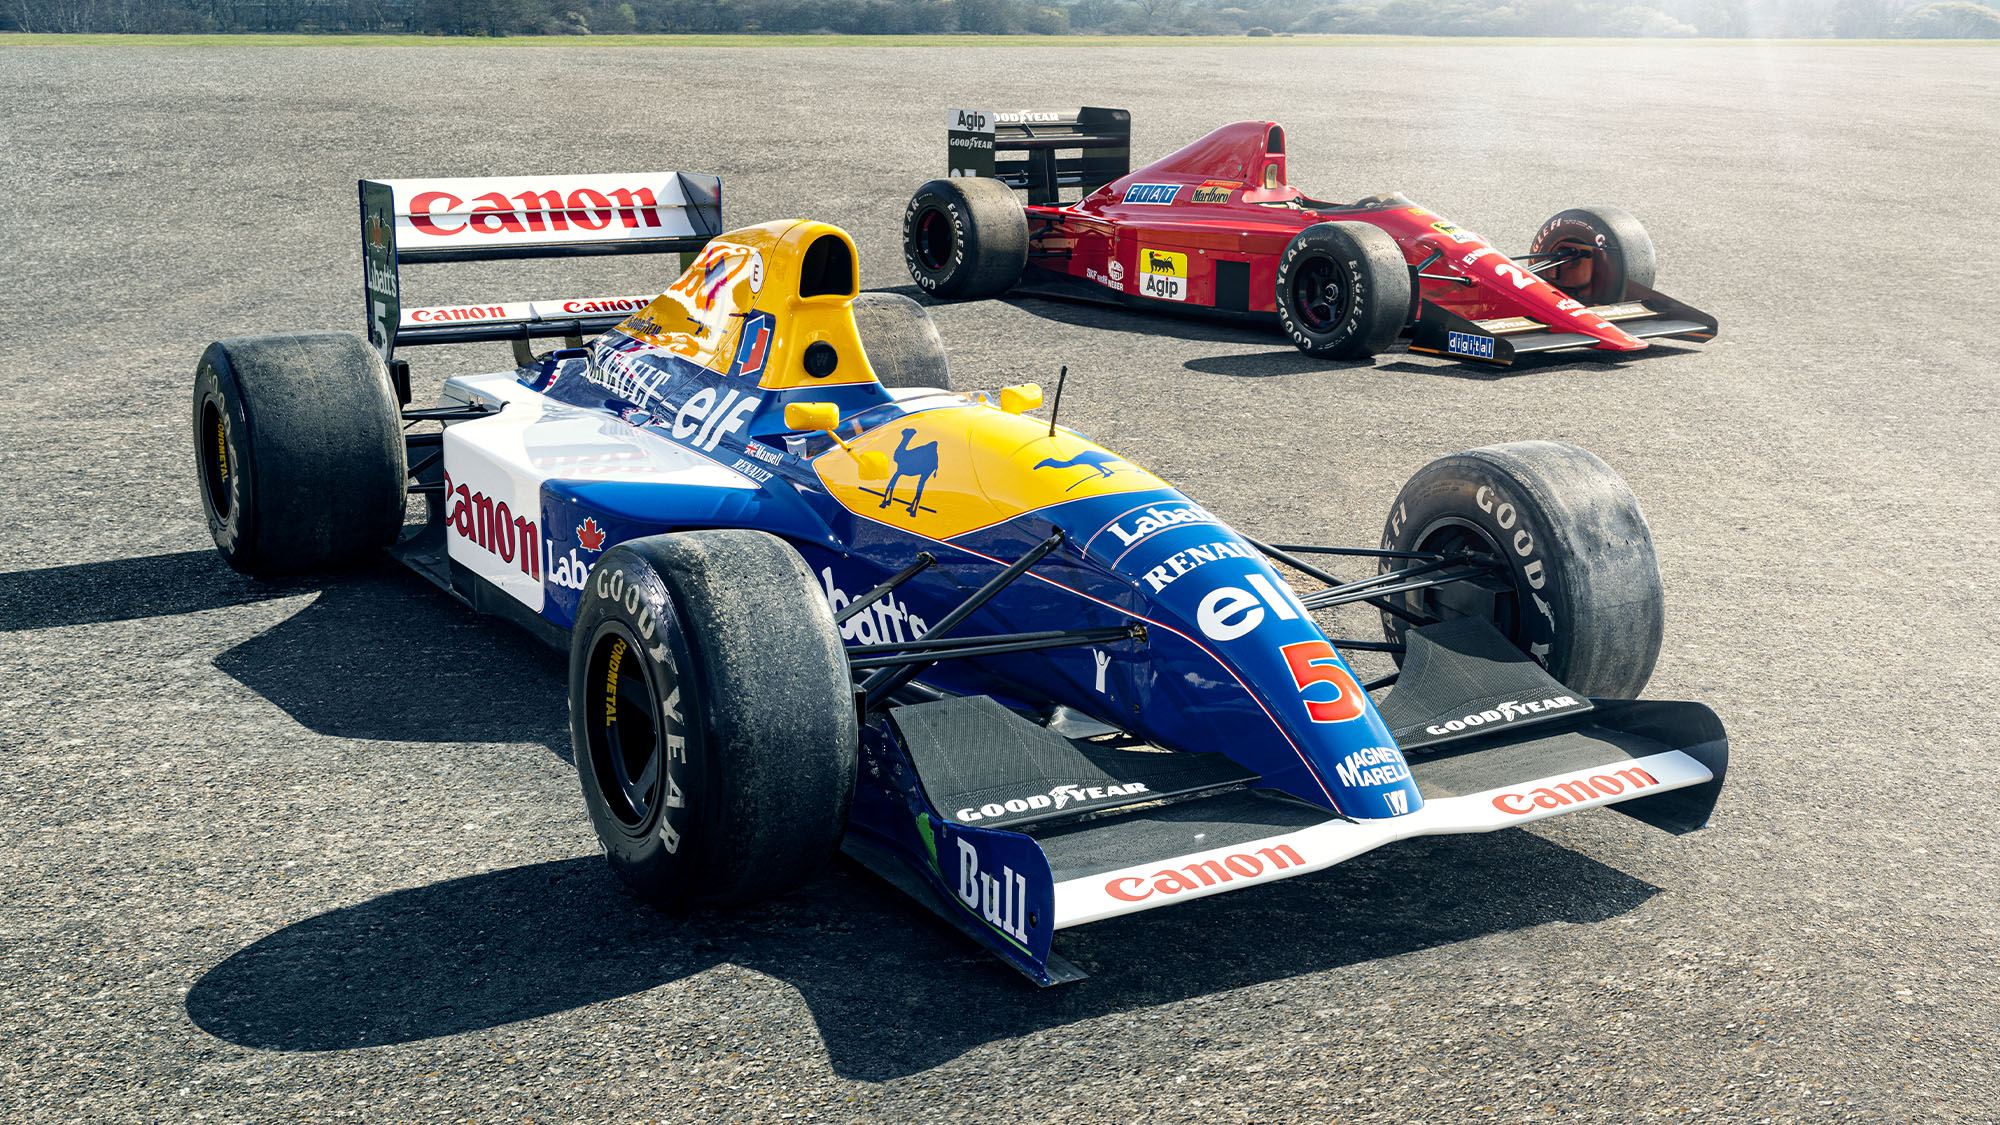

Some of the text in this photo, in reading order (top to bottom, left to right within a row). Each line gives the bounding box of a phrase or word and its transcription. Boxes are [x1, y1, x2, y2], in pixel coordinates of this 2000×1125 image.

[957, 110, 986, 131] Agip
[994, 110, 1060, 123] OODYEAR
[950, 137, 993, 149] GOODYEAR
[1126, 184, 1180, 203] FIAT
[1193, 187, 1229, 203] Marlboro
[409, 187, 662, 236] Canon
[1146, 274, 1179, 298] Agip
[412, 306, 506, 322] Canon
[563, 297, 649, 314] Canon
[1449, 332, 1493, 357] digital
[671, 386, 762, 453] elf
[217, 417, 230, 484] FONDMETAL
[754, 445, 784, 467] Mansell
[731, 458, 774, 483] RENAULT
[1142, 541, 1260, 595] RENAU
[606, 638, 627, 727] FONDMETAL
[1278, 639, 1366, 724] 5
[1425, 695, 1580, 737] GOODYEAR
[957, 782, 1150, 822] GOODYEAR
[1492, 767, 1660, 815] Canon
[1105, 843, 1306, 902] Canon
[956, 837, 1028, 945] Bull
